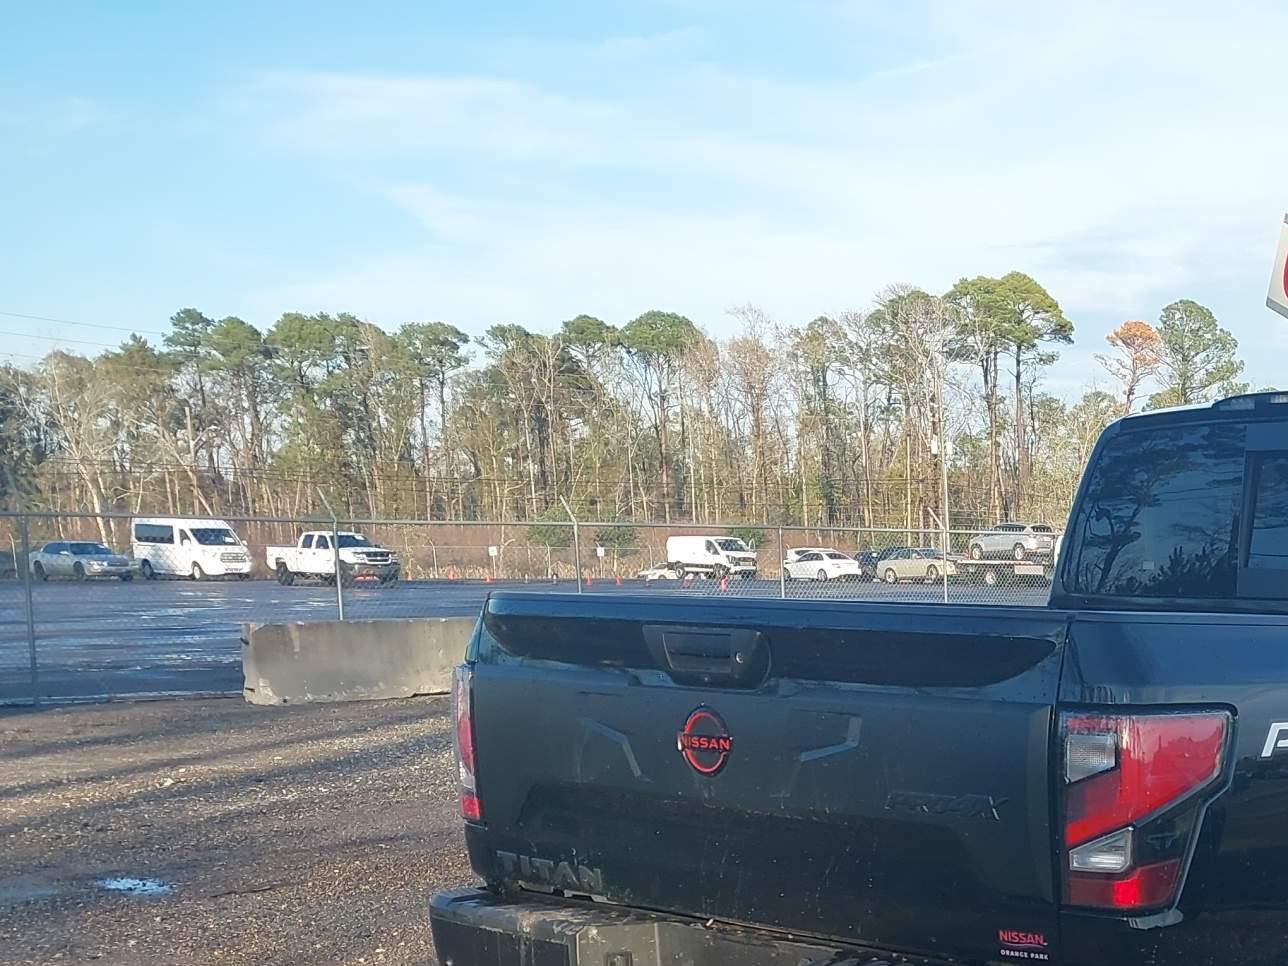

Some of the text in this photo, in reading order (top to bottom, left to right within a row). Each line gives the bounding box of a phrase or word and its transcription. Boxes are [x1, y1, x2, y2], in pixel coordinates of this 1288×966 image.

[680, 735, 731, 750] NISSAN
[496, 849, 602, 893] TITAN
[999, 929, 1045, 945] NISSAN
[1030, 952, 1049, 961] PARK
